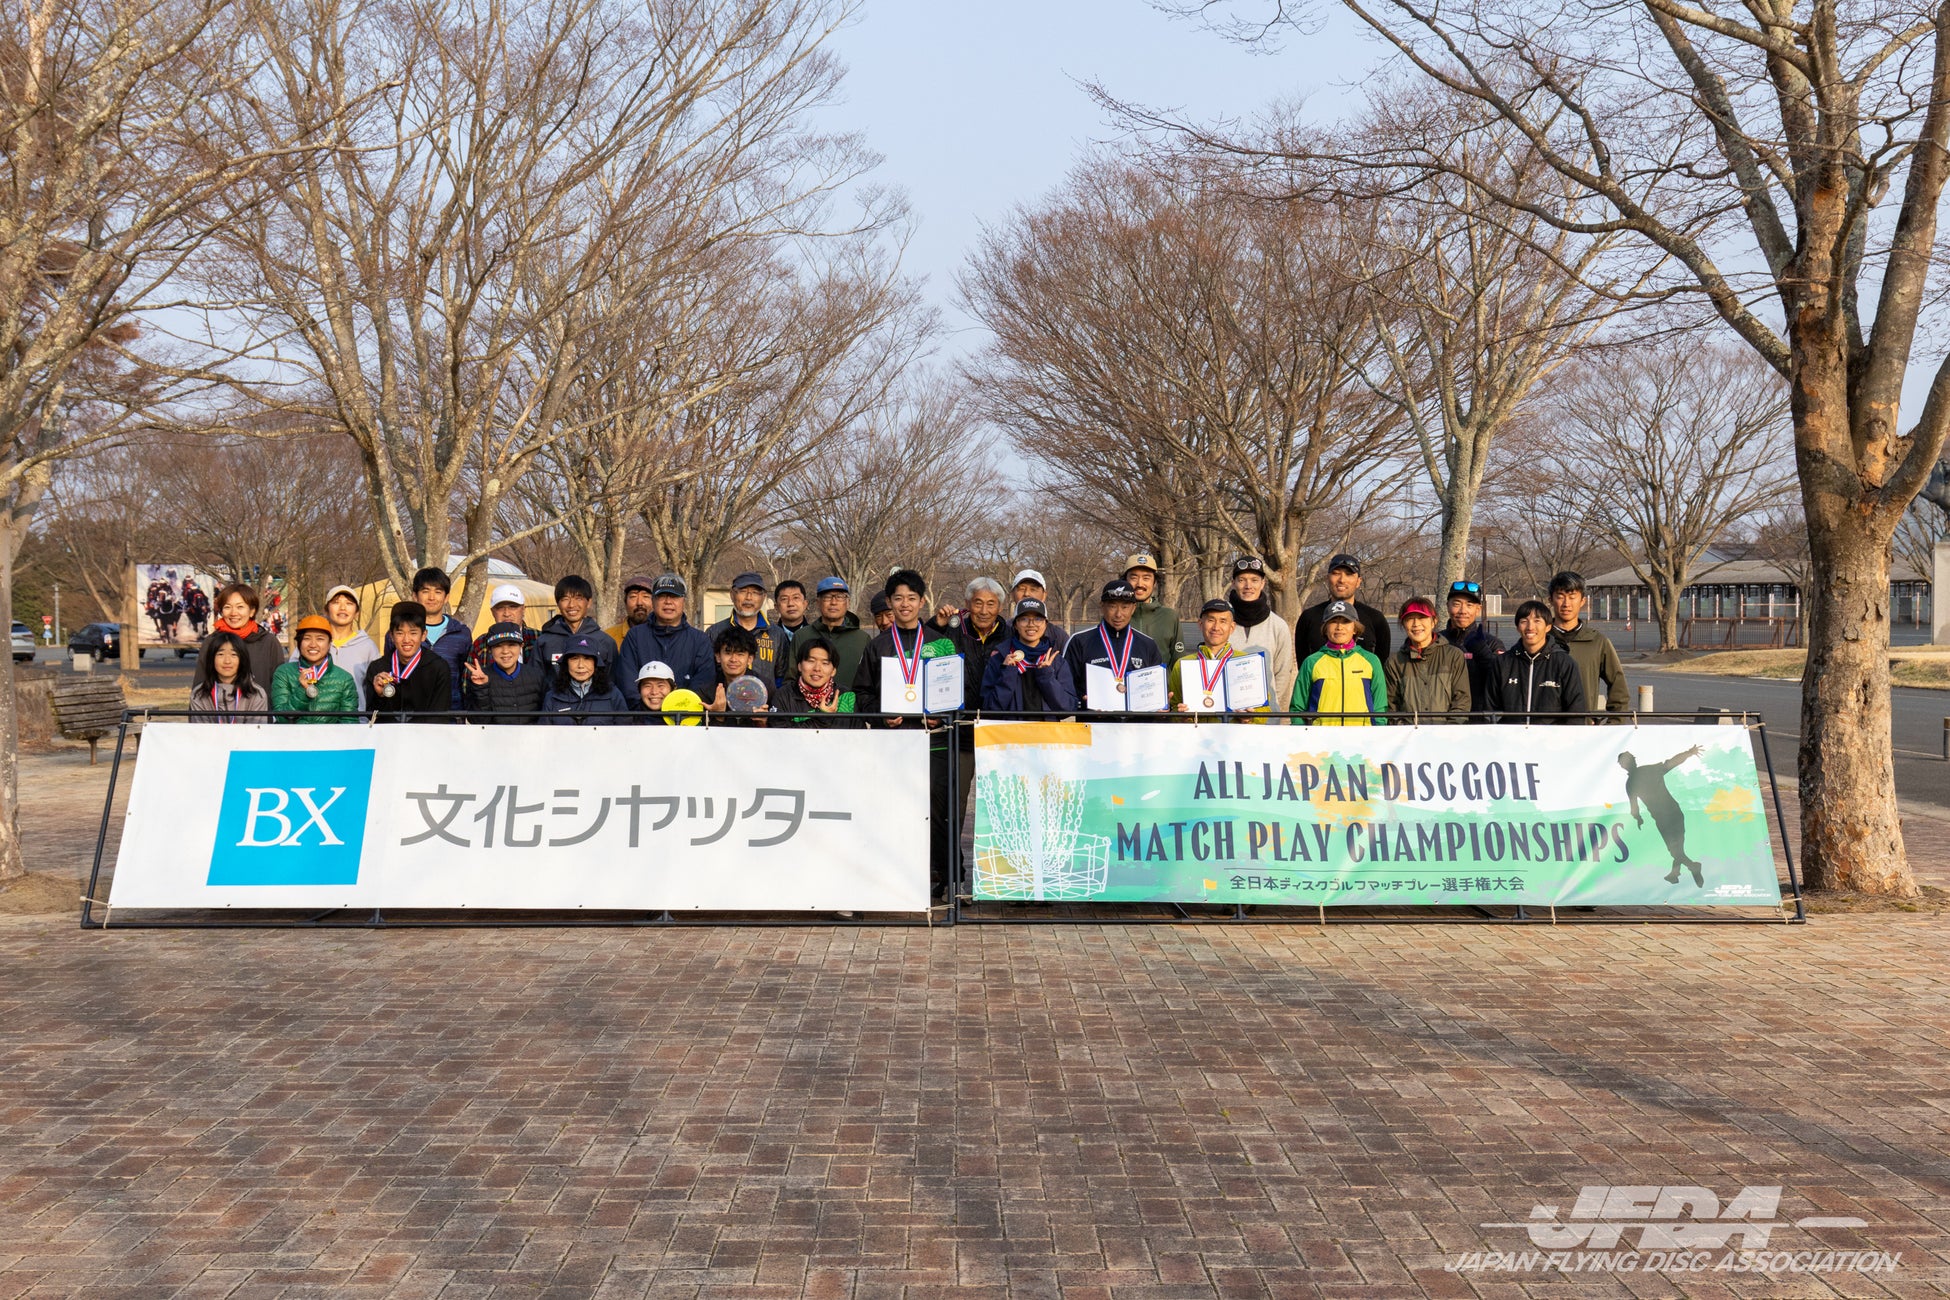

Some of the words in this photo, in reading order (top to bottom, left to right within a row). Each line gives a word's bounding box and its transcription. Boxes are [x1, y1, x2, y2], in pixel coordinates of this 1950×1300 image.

[1193, 760, 1251, 800] ALL
[1262, 762, 1369, 802] JAPAN
[1380, 761, 1541, 801] DISCGOLF
[235, 786, 347, 847] BX
[1116, 821, 1235, 861] MATCH
[1248, 821, 1332, 862] PLAY
[1346, 821, 1630, 863] CHAMPIONSHIPS
[1230, 875, 1525, 892] 全日本ディスクゴルフマッチプレー選手権大会
